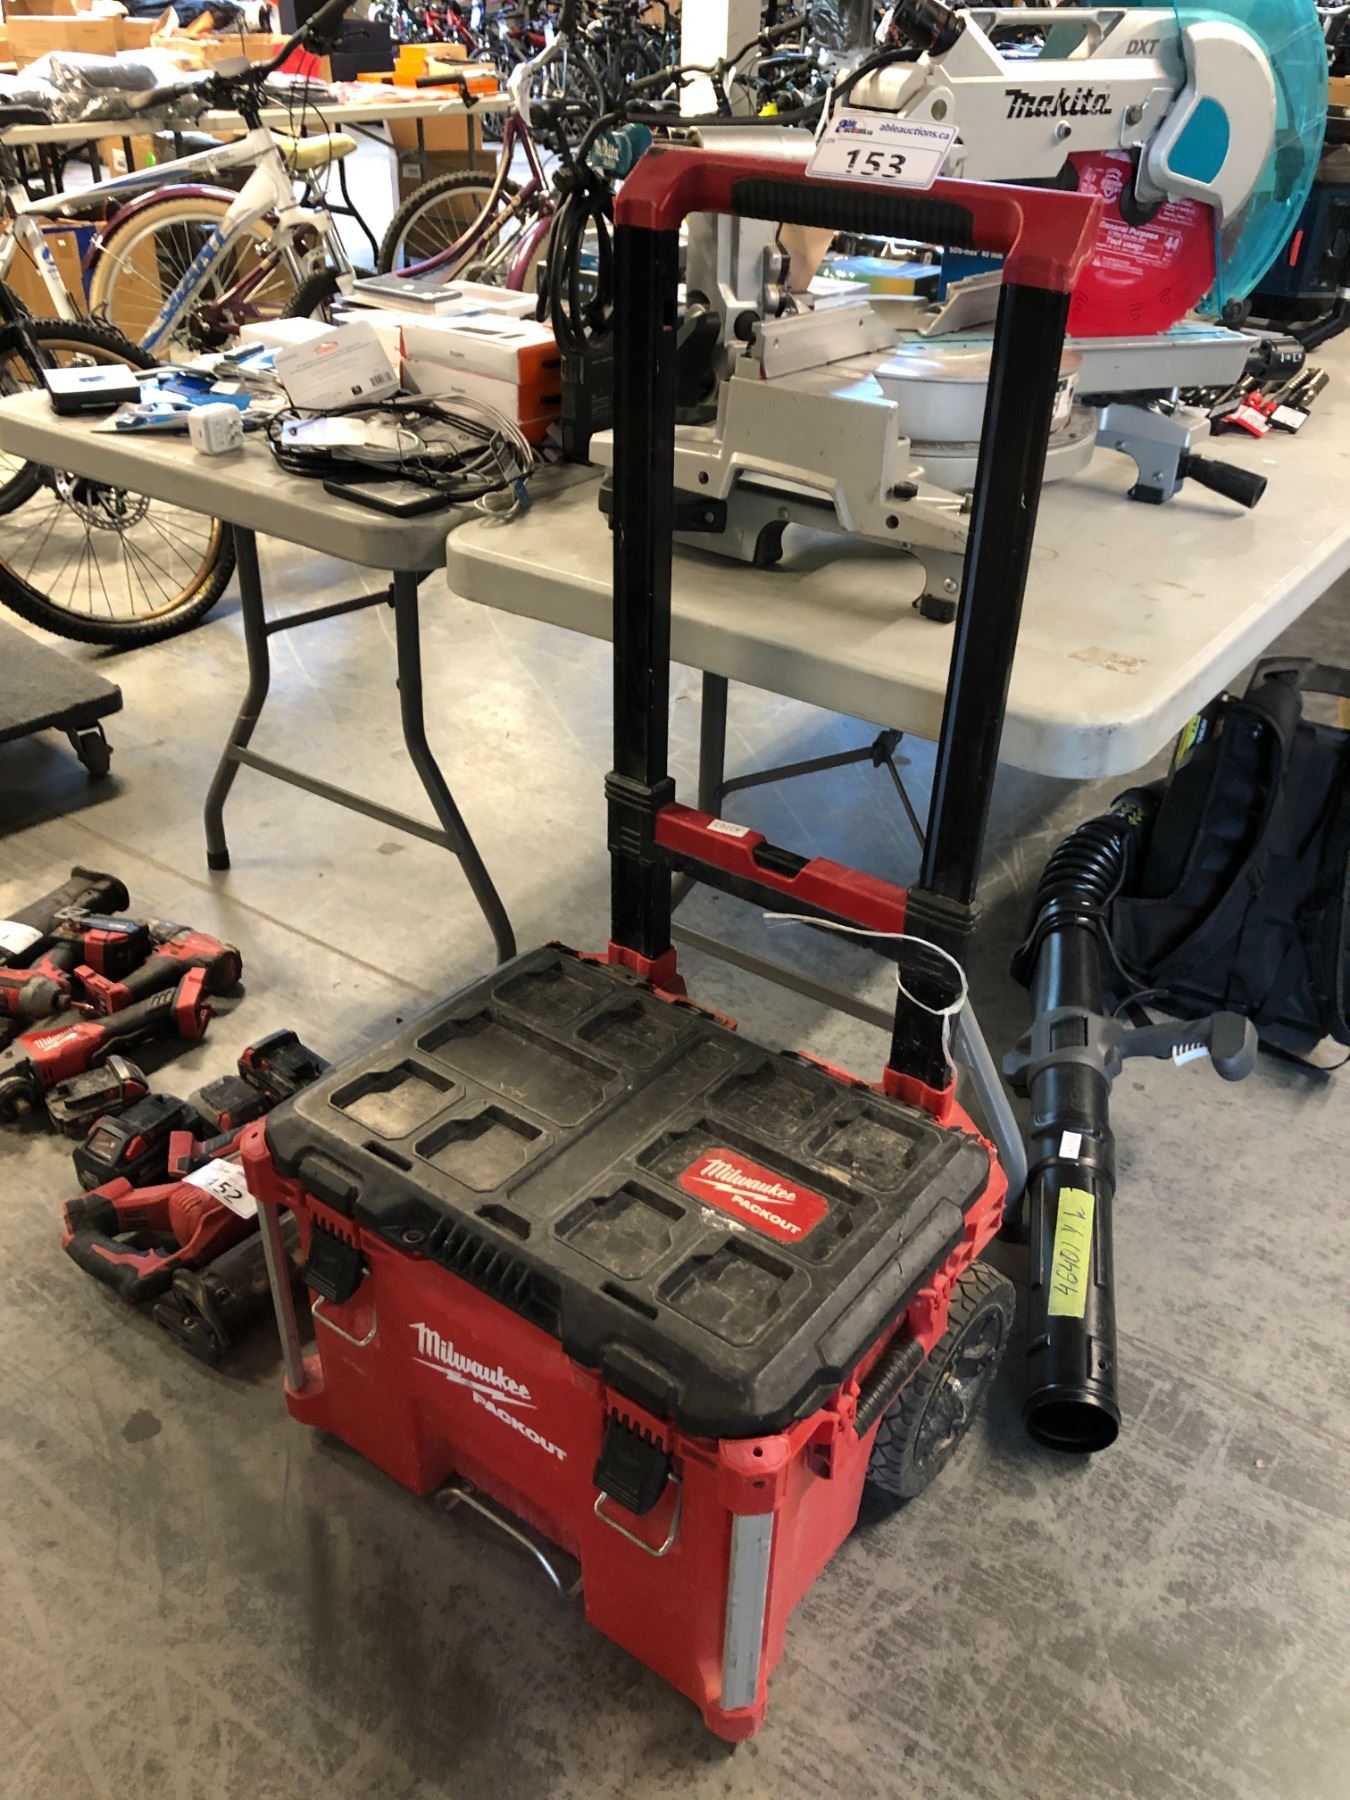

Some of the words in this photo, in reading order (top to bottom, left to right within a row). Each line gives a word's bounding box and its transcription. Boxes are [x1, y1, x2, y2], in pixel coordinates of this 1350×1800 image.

[1126, 38, 1160, 55] DXT
[1005, 86, 1112, 119] Makita
[879, 122, 951, 141] ableauctions.ca
[847, 149, 906, 178] 153
[700, 1159, 797, 1201] Milwaukee
[731, 1195, 802, 1234] PACKOUT
[408, 1322, 532, 1400] Milwaukee
[472, 1390, 568, 1461] PACKOUT
